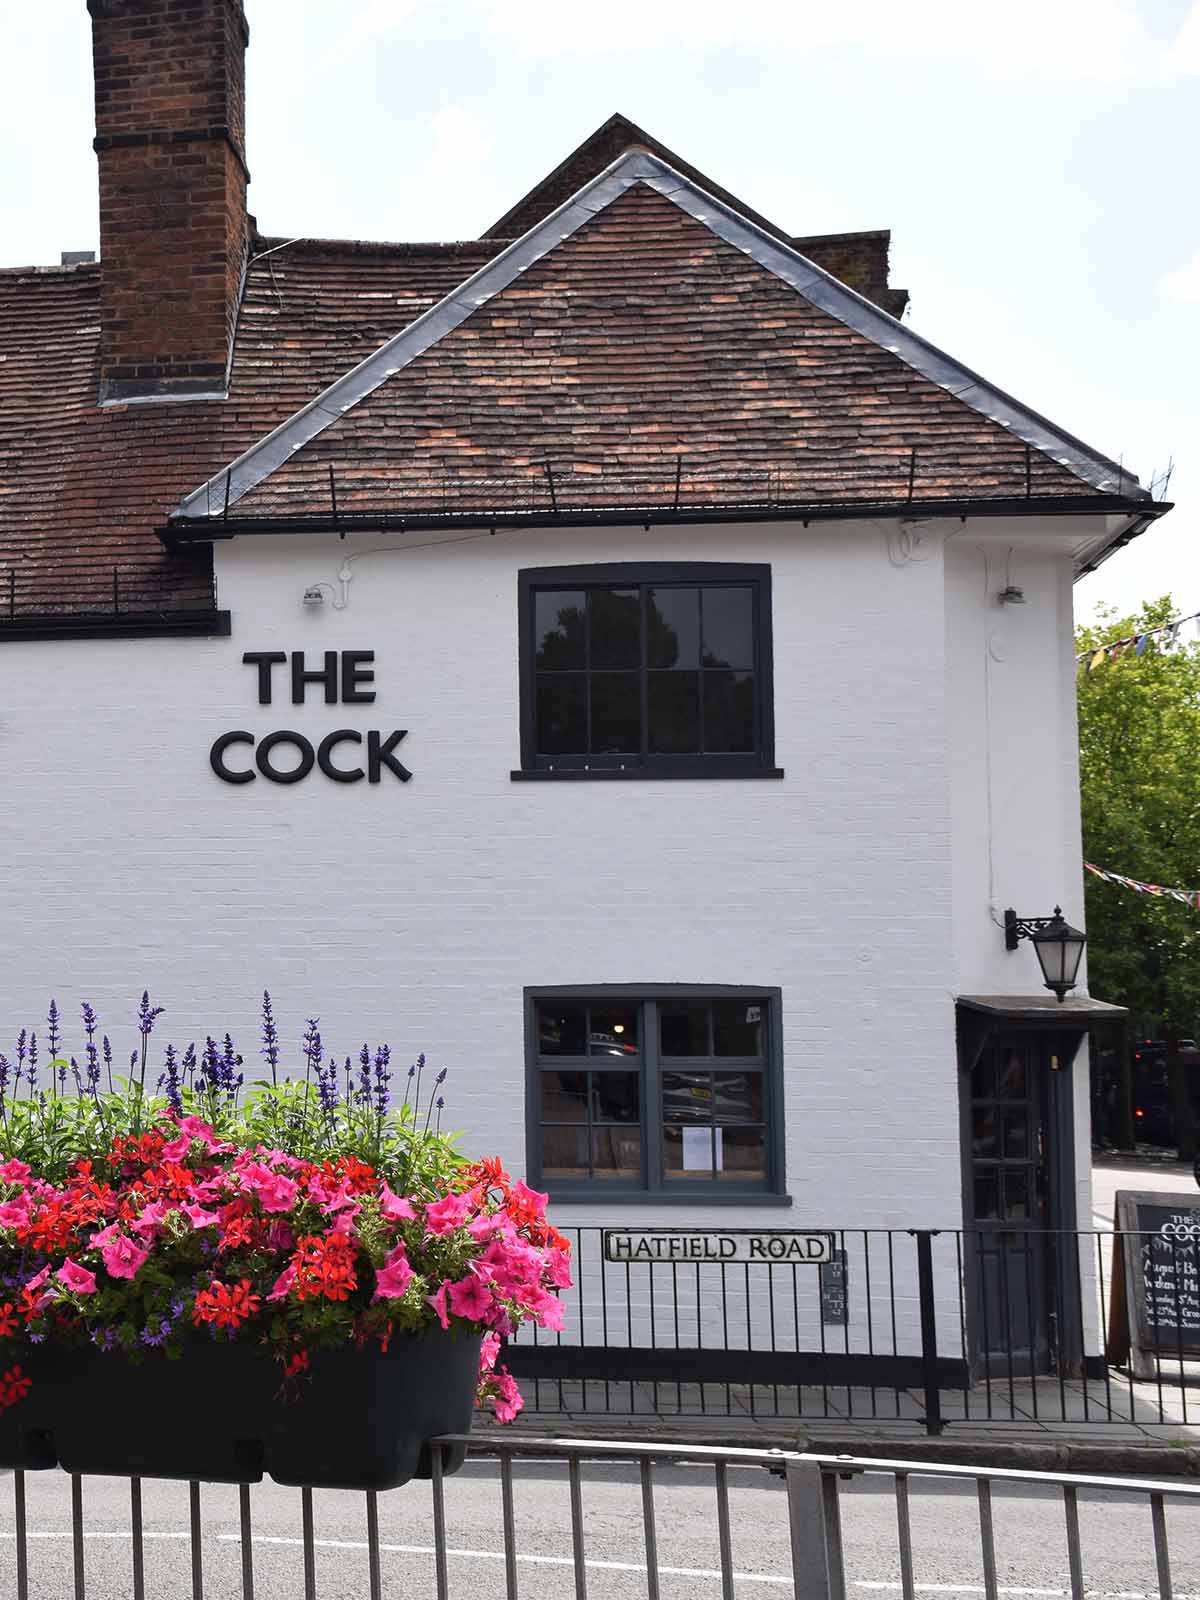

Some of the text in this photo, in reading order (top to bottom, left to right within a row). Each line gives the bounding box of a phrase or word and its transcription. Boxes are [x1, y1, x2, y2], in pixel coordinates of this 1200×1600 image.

[242, 649, 377, 705] THE
[209, 729, 413, 785] COCK
[1170, 1215, 1193, 1224] THE
[615, 1236, 825, 1259] HATFIELD ROAD
